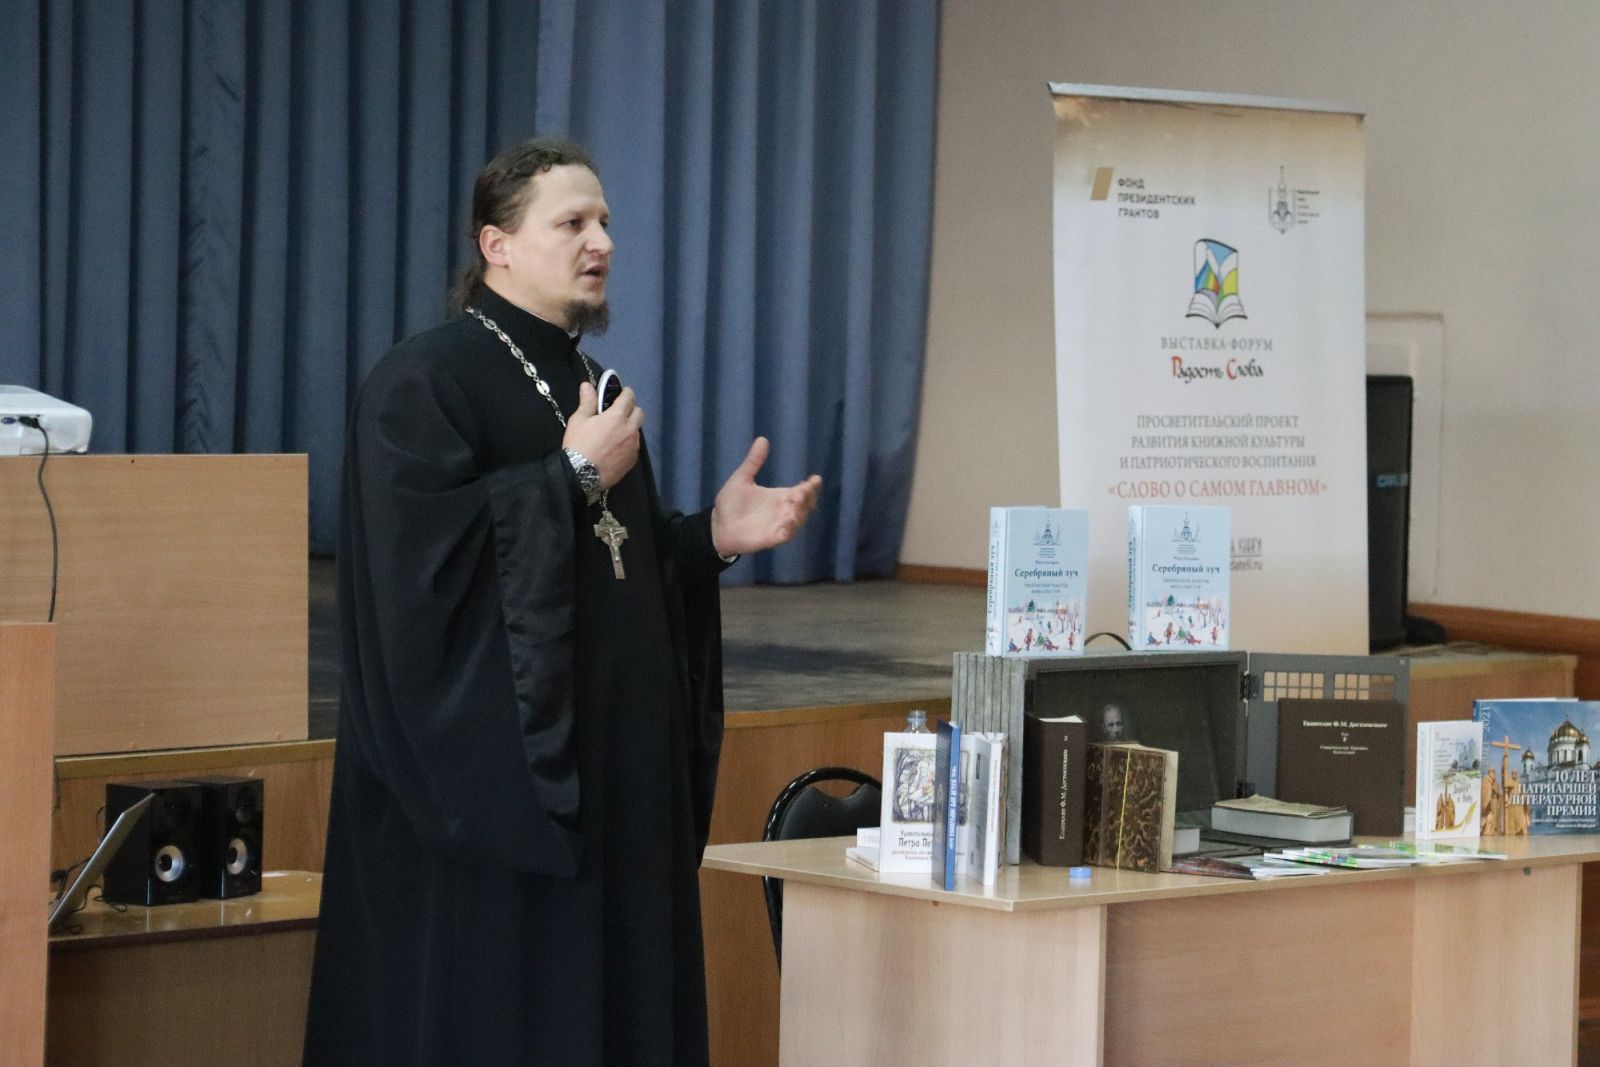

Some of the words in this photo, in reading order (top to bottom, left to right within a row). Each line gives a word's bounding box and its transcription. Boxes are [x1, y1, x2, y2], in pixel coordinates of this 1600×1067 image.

[1118, 178, 1144, 189] ФОНД
[1118, 193, 1196, 205] ПРЕЗИДЕНТСКИХ
[1118, 208, 1160, 219] ГРАНТОВ
[1171, 355, 1224, 384] Радость
[1226, 358, 1264, 380] Слова
[1137, 414, 1252, 429] ПРОСВЕТИТЕЛЬСКИЙ
[1255, 416, 1299, 428] ПРОЕКТ
[1131, 436, 1189, 449] РАЗВИТИЯ
[1191, 434, 1249, 448] КНИЖНОЙ
[1251, 435, 1306, 448] КУЛЬТУРЫ
[1119, 457, 1129, 469] И
[1131, 456, 1240, 469] ПАТРИОТИЧЕСКОГО
[1243, 455, 1317, 468] ВОСПИТАНИЯ
[1108, 480, 1170, 498] «СЛОВО
[1174, 480, 1186, 497] О
[1189, 480, 1245, 497] САМОМ
[1249, 479, 1328, 496] ГЛАВНОМ»
[1014, 568, 1063, 579] Серебряный
[1065, 570, 1079, 580] луч
[1152, 563, 1204, 575] Серебряный
[1206, 566, 1220, 576] луч
[1555, 770, 1568, 782] 10
[1569, 770, 1597, 783] ЛЕТ
[1518, 783, 1597, 794] ПАТРИАРШЕЙ
[1505, 793, 1597, 806] ЛИТЕРАТУРНОЙ
[1547, 805, 1597, 816] ПРЕМИИ
[899, 838, 919, 849] Петра
